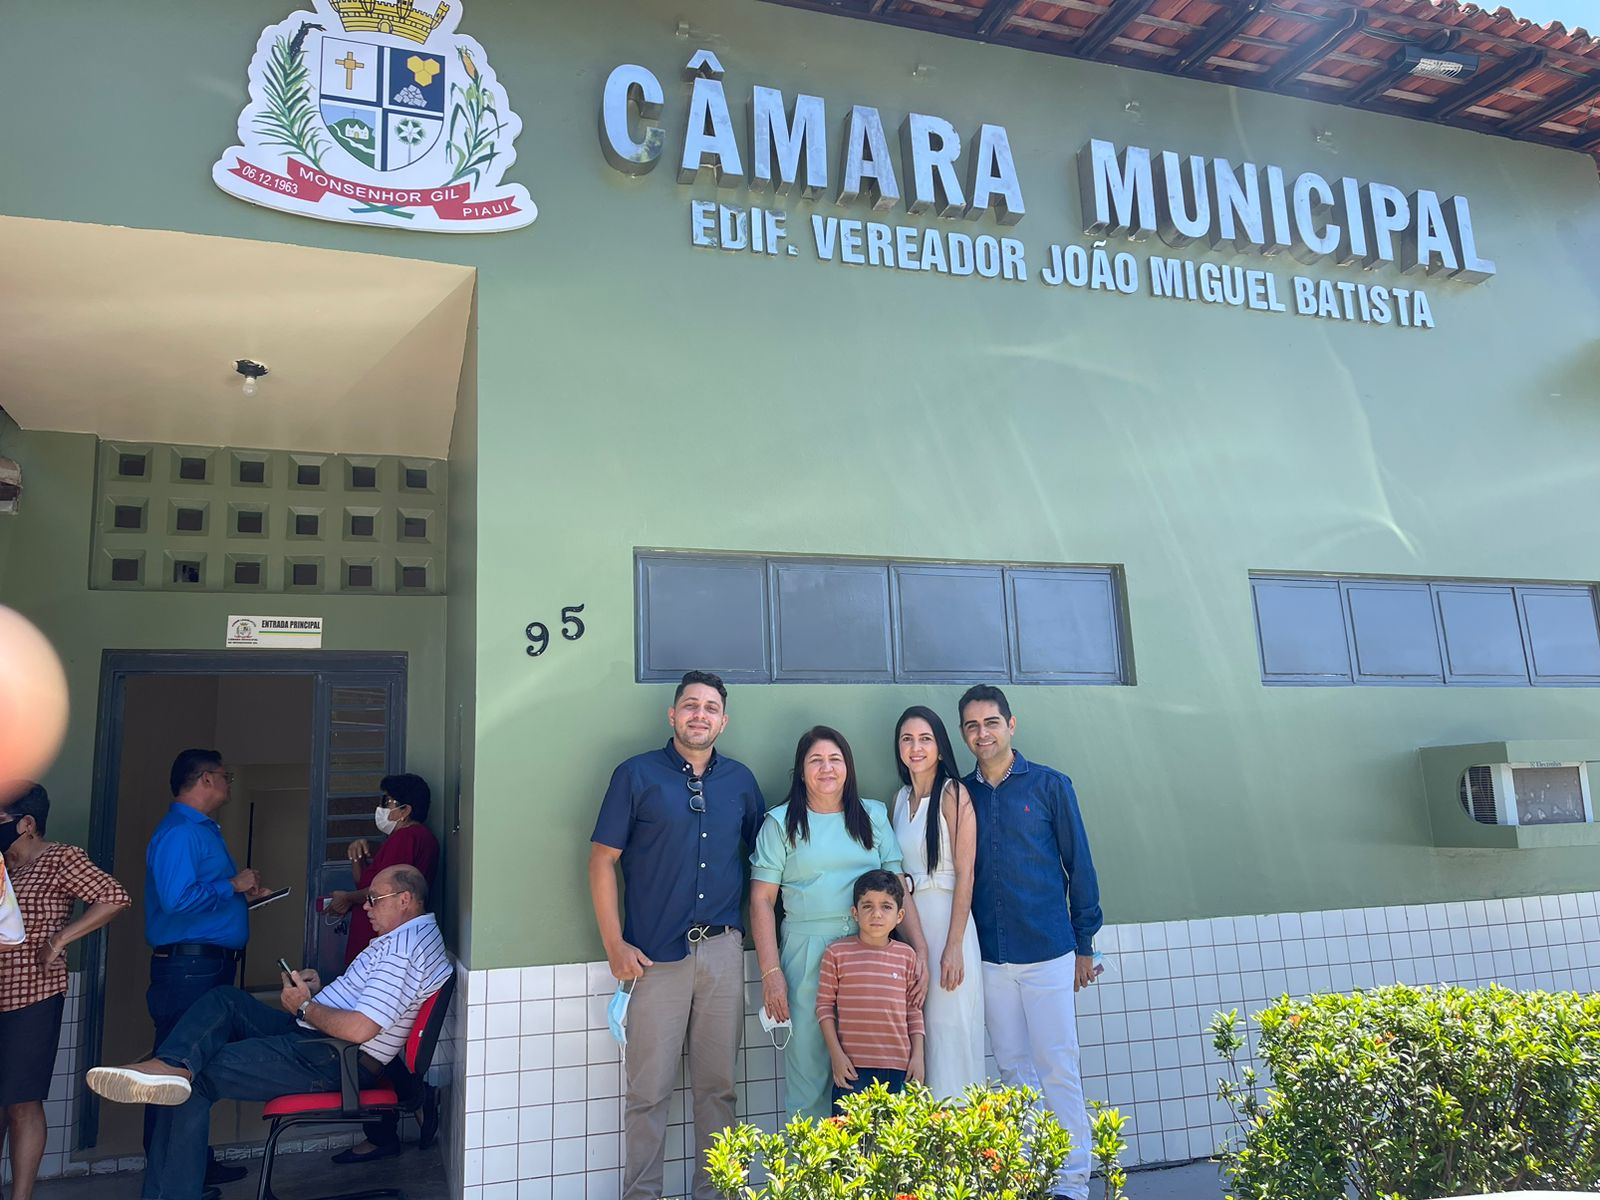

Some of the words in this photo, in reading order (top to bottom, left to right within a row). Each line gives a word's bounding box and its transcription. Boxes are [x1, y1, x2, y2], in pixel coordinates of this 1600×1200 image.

[241, 165, 299, 195] 06.12.1963
[299, 166, 422, 203] MONSENHOR
[430, 188, 460, 202] GIL
[601, 49, 1026, 223] CÂMARA
[1079, 137, 1497, 282] MUNICIPAL
[691, 199, 799, 256] EDIF.
[810, 214, 1028, 282] VEREADOR
[1040, 239, 1139, 294] JOÃO
[1148, 255, 1287, 313] MIGUEL
[1292, 275, 1435, 329] BATISTA
[261, 620, 288, 629] ENTRADA
[289, 620, 320, 630] PRINCIPAL
[525, 603, 585, 657] 95
